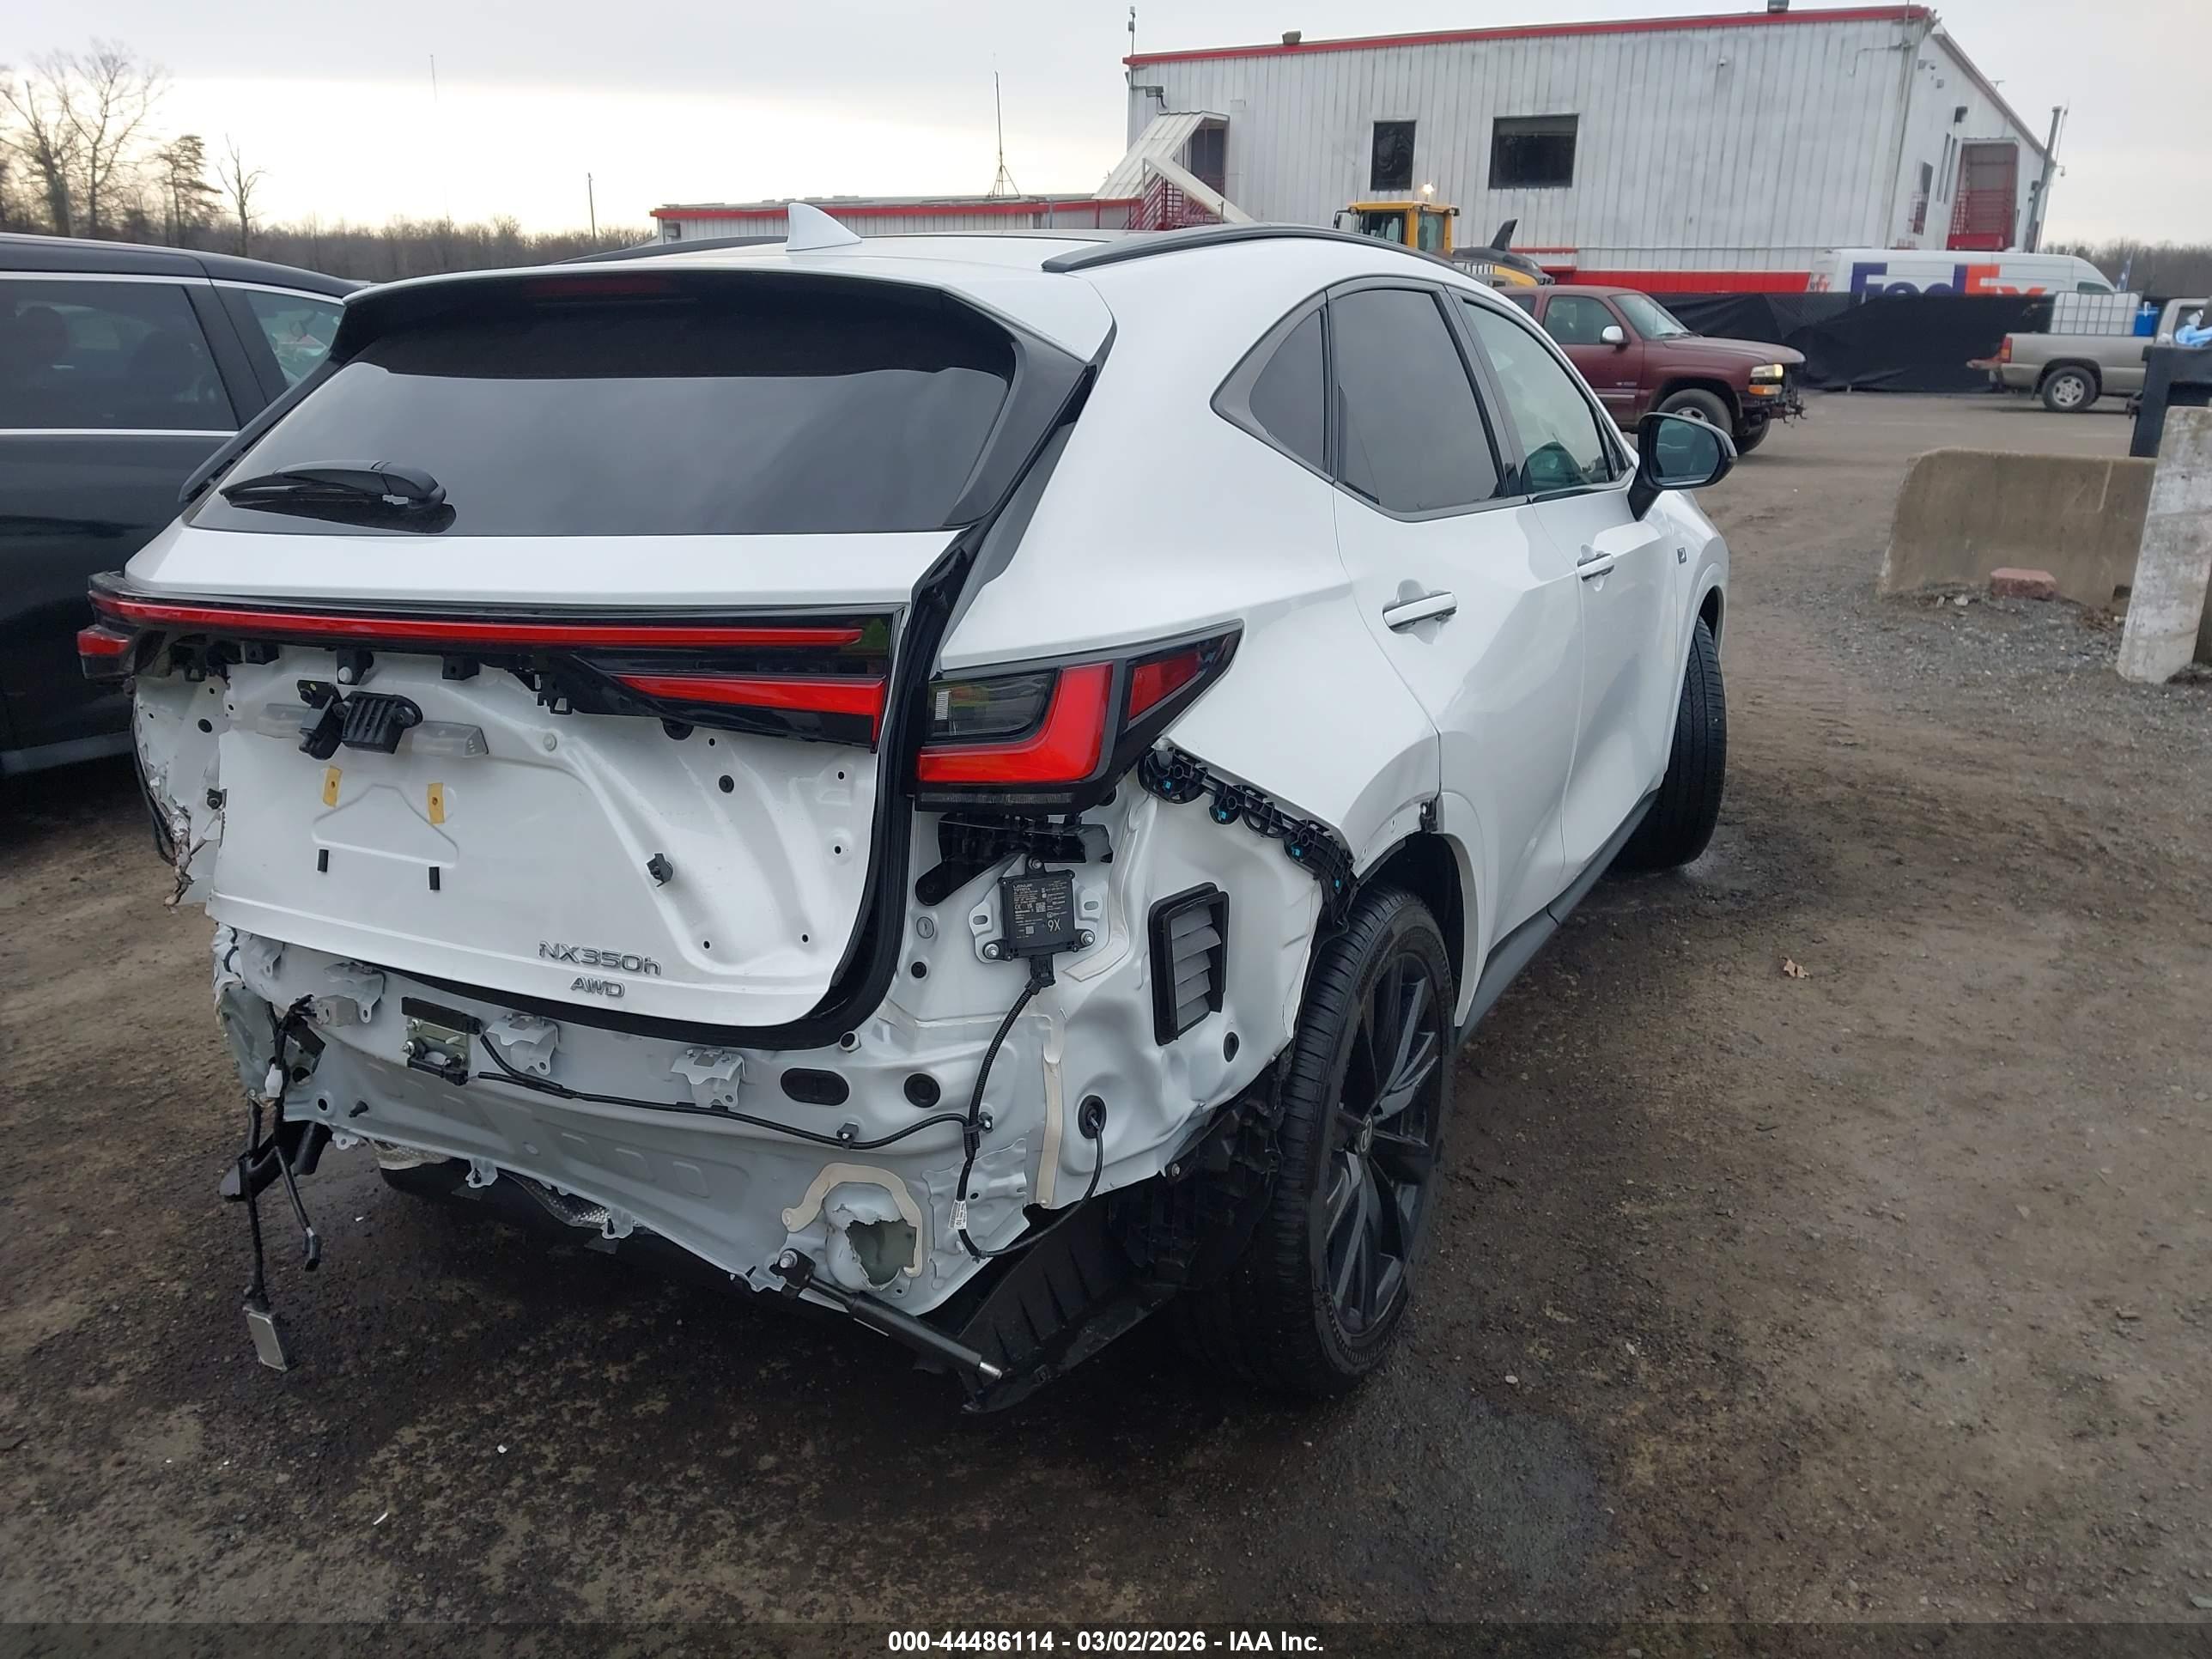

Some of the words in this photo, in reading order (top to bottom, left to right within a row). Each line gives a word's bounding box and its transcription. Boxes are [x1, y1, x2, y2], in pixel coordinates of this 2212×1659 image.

[1048, 919, 1060, 932] 9X
[538, 940, 661, 975] NX350h
[570, 975, 625, 998] AWD
